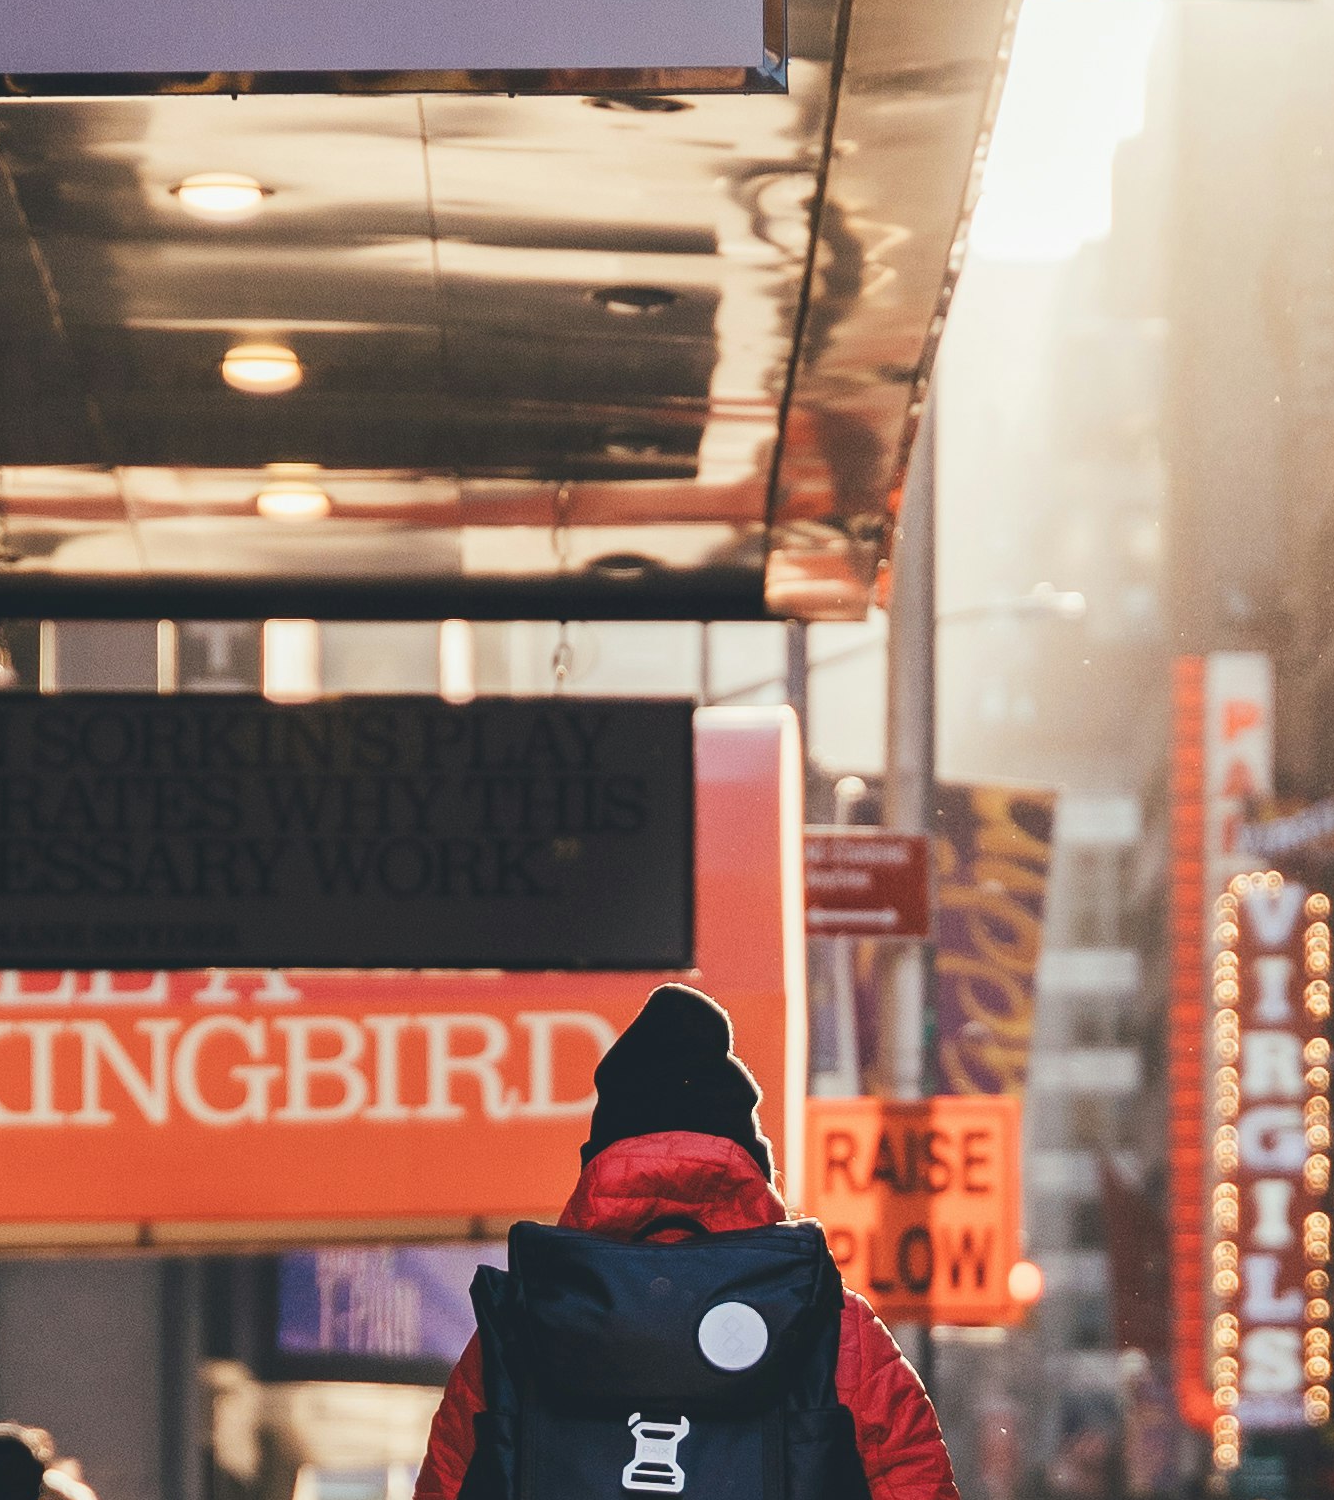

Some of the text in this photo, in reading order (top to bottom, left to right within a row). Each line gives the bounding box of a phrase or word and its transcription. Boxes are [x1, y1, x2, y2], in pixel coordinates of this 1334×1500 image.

[420, 710, 610, 770] PLAY
[261, 772, 444, 834] WHY
[461, 772, 651, 835] THIS
[824, 1129, 989, 1194] RAISE
[826, 1226, 995, 1293] PLOW
